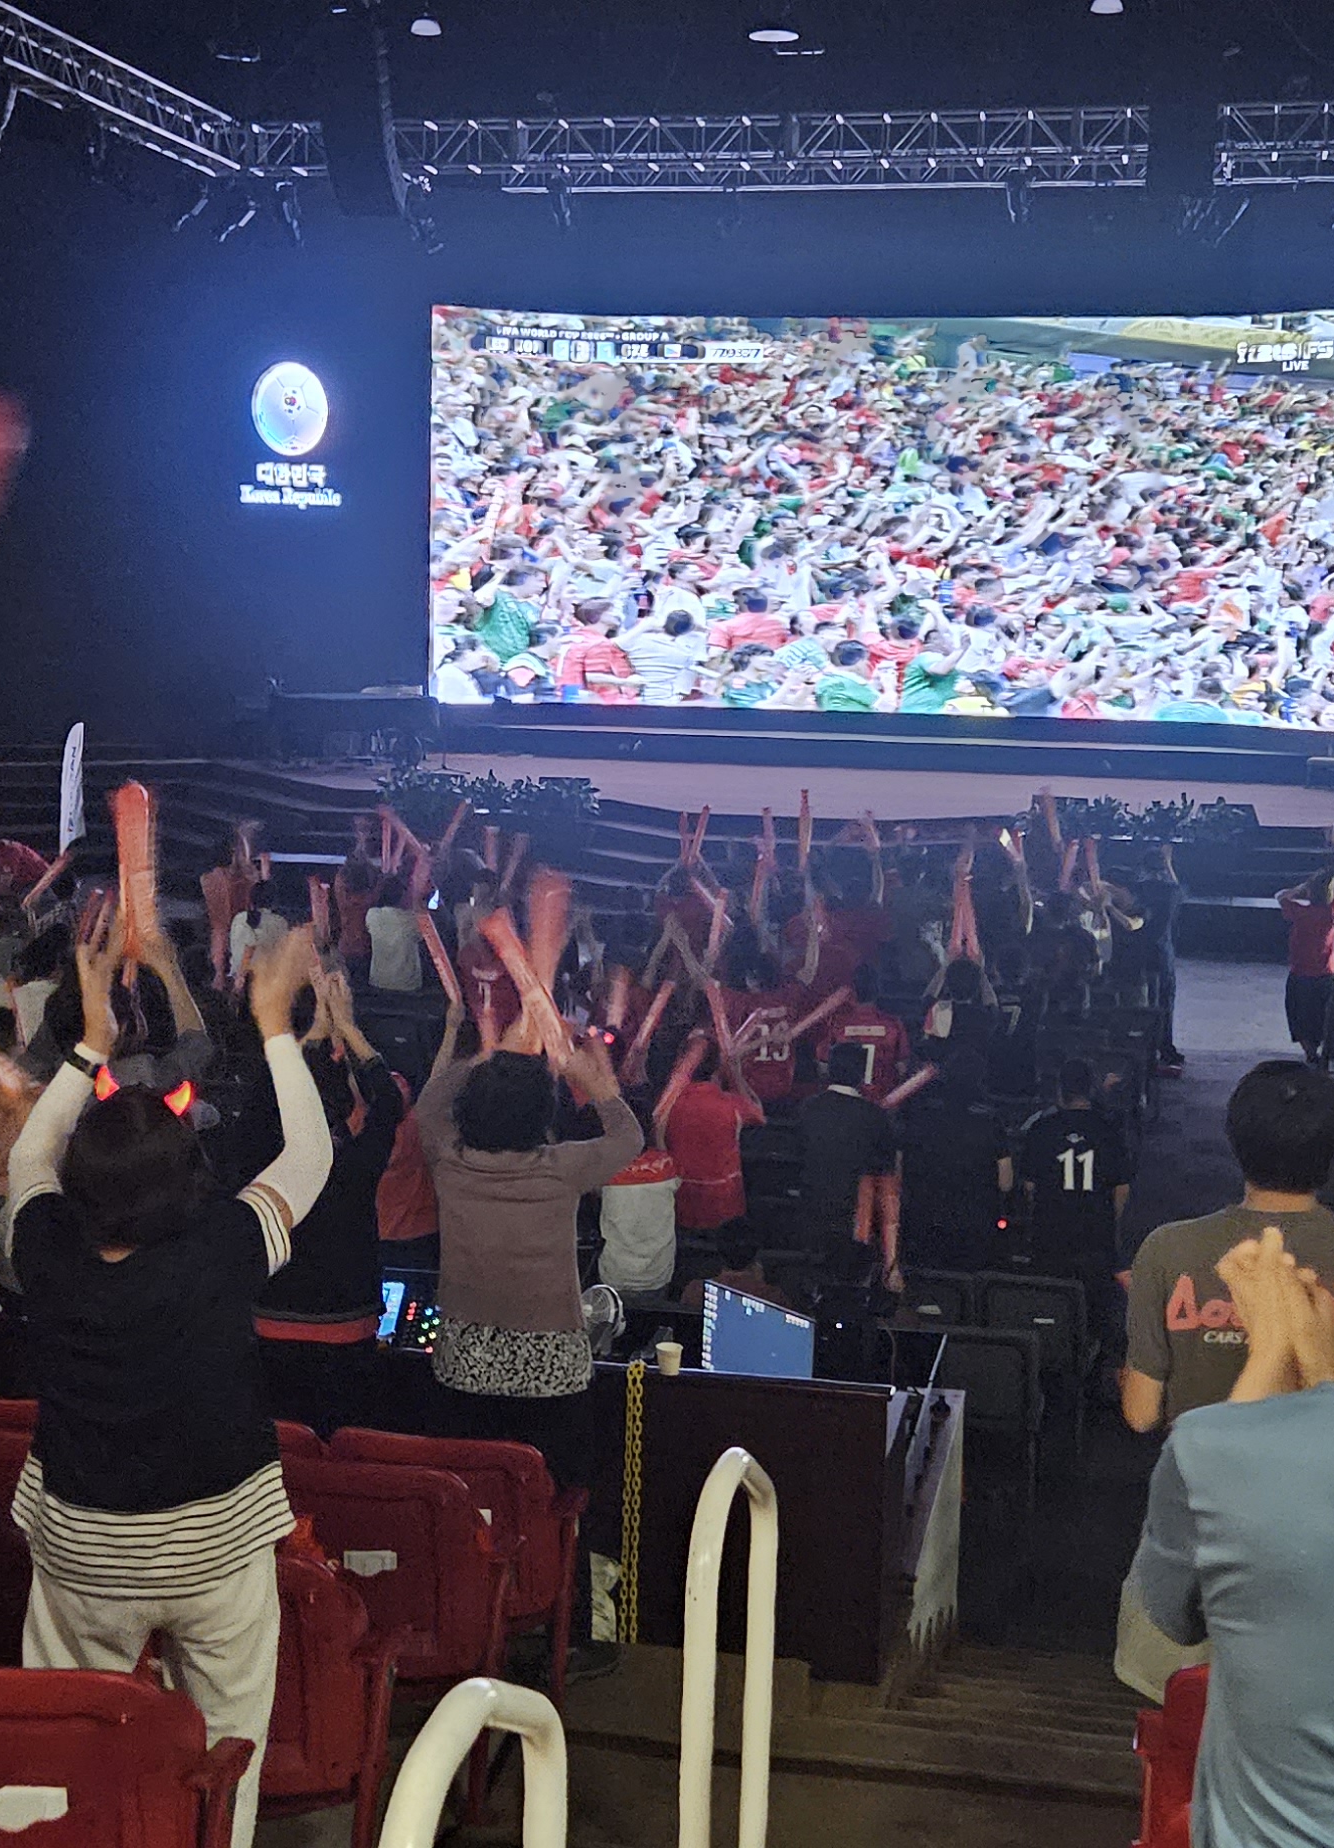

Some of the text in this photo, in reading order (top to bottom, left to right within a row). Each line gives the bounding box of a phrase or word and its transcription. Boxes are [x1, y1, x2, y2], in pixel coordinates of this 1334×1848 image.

[520, 328, 556, 340] WORLD
[621, 331, 658, 343] GROUP
[659, 332, 670, 342] A
[1281, 361, 1310, 373] LIVE
[255, 461, 328, 488] 대한민국
[1055, 1148, 1095, 1192] 11
[1202, 1330, 1243, 1344] CARS
